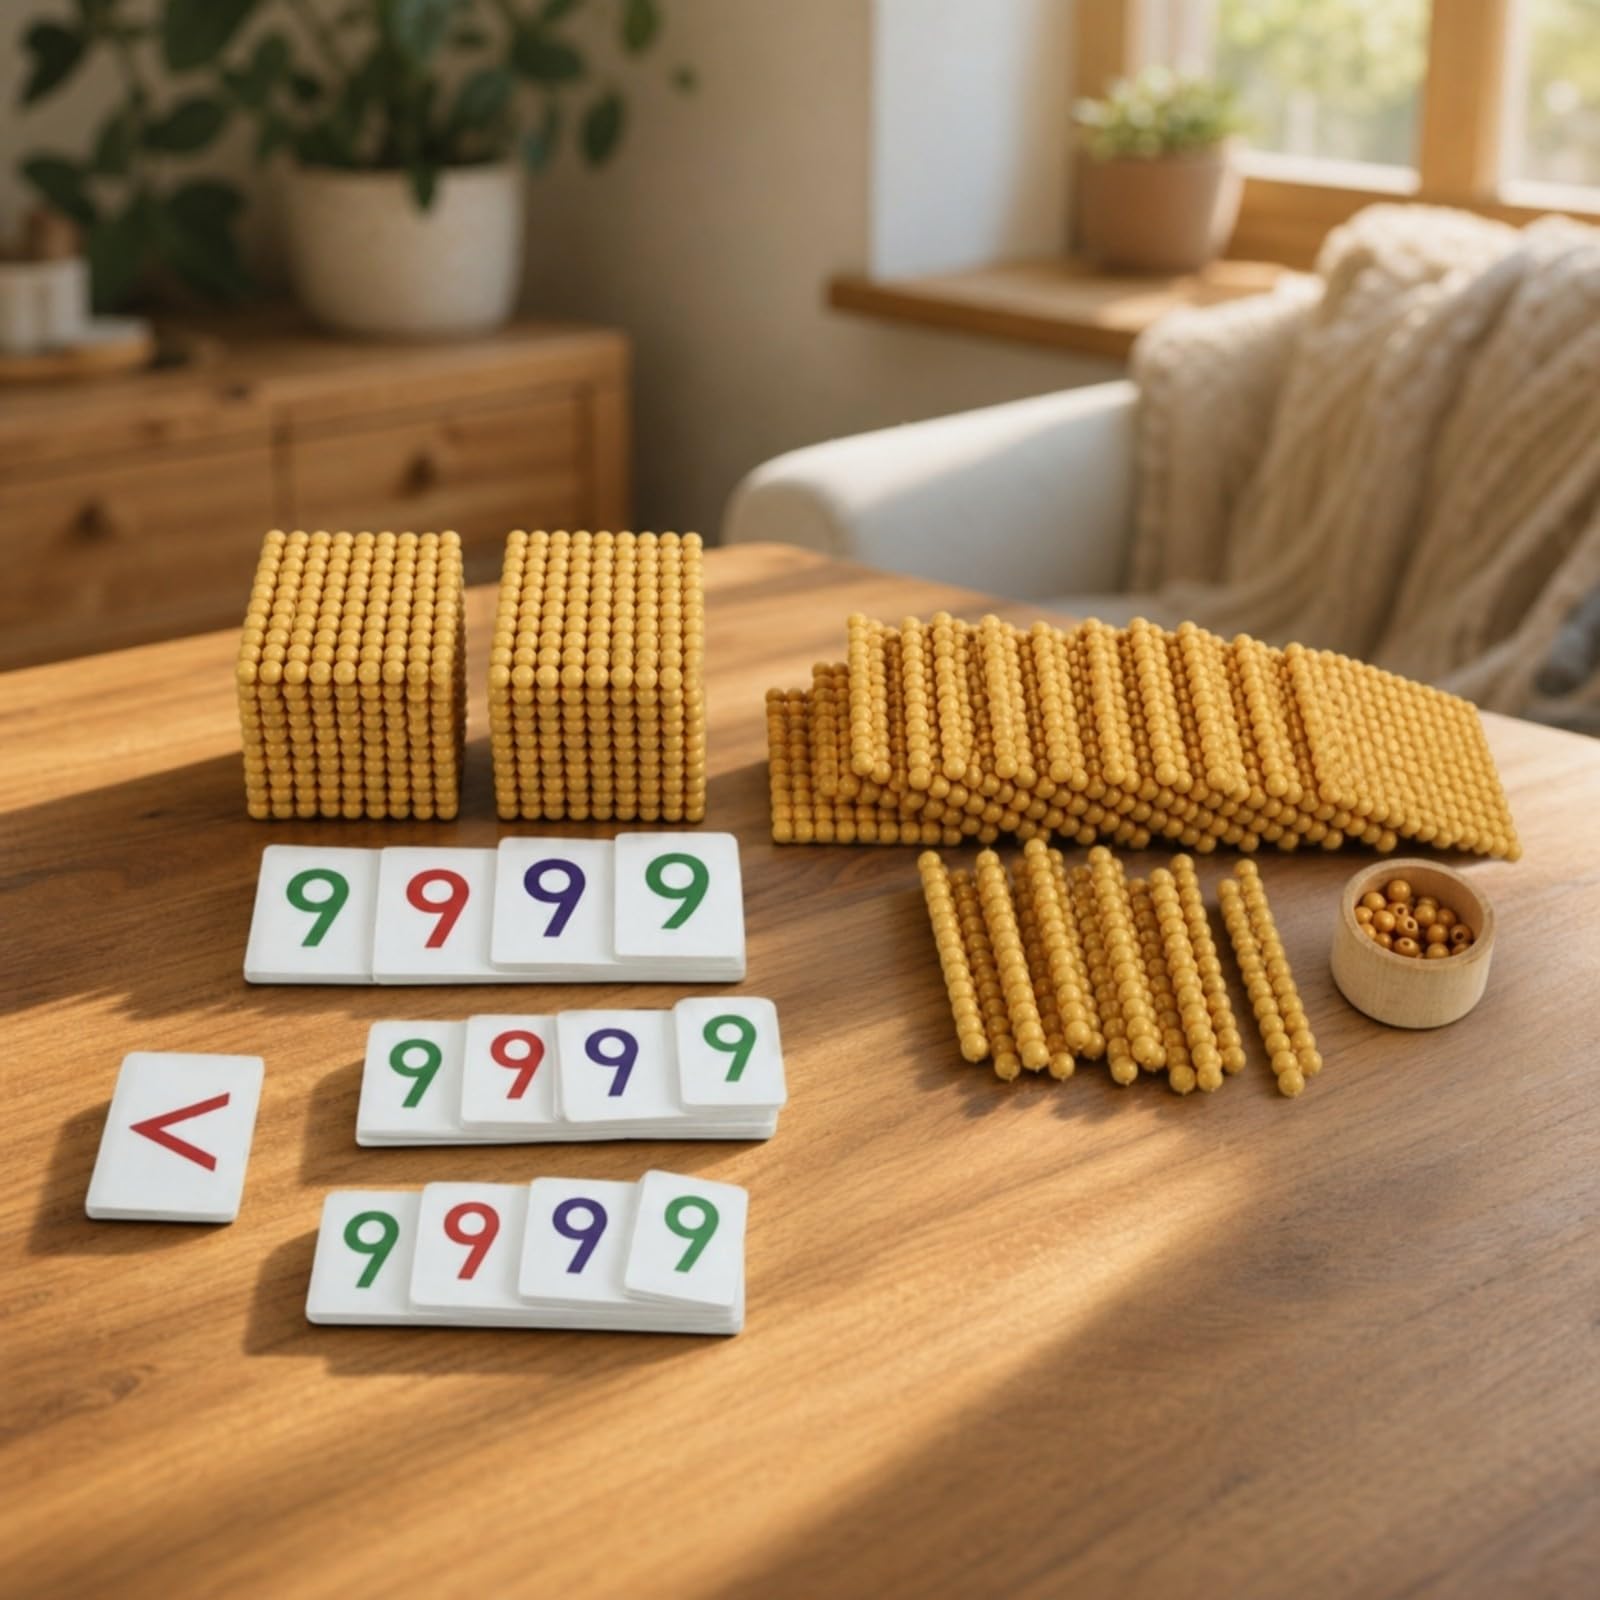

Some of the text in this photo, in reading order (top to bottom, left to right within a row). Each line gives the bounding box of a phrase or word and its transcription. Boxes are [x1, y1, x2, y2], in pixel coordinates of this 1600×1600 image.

[285, 852, 710, 949] 9 9 9 9
[388, 1014, 757, 1108] 9 9 9 9
[129, 1092, 231, 1172] <
[343, 1195, 721, 1289] 9 9 9 9
